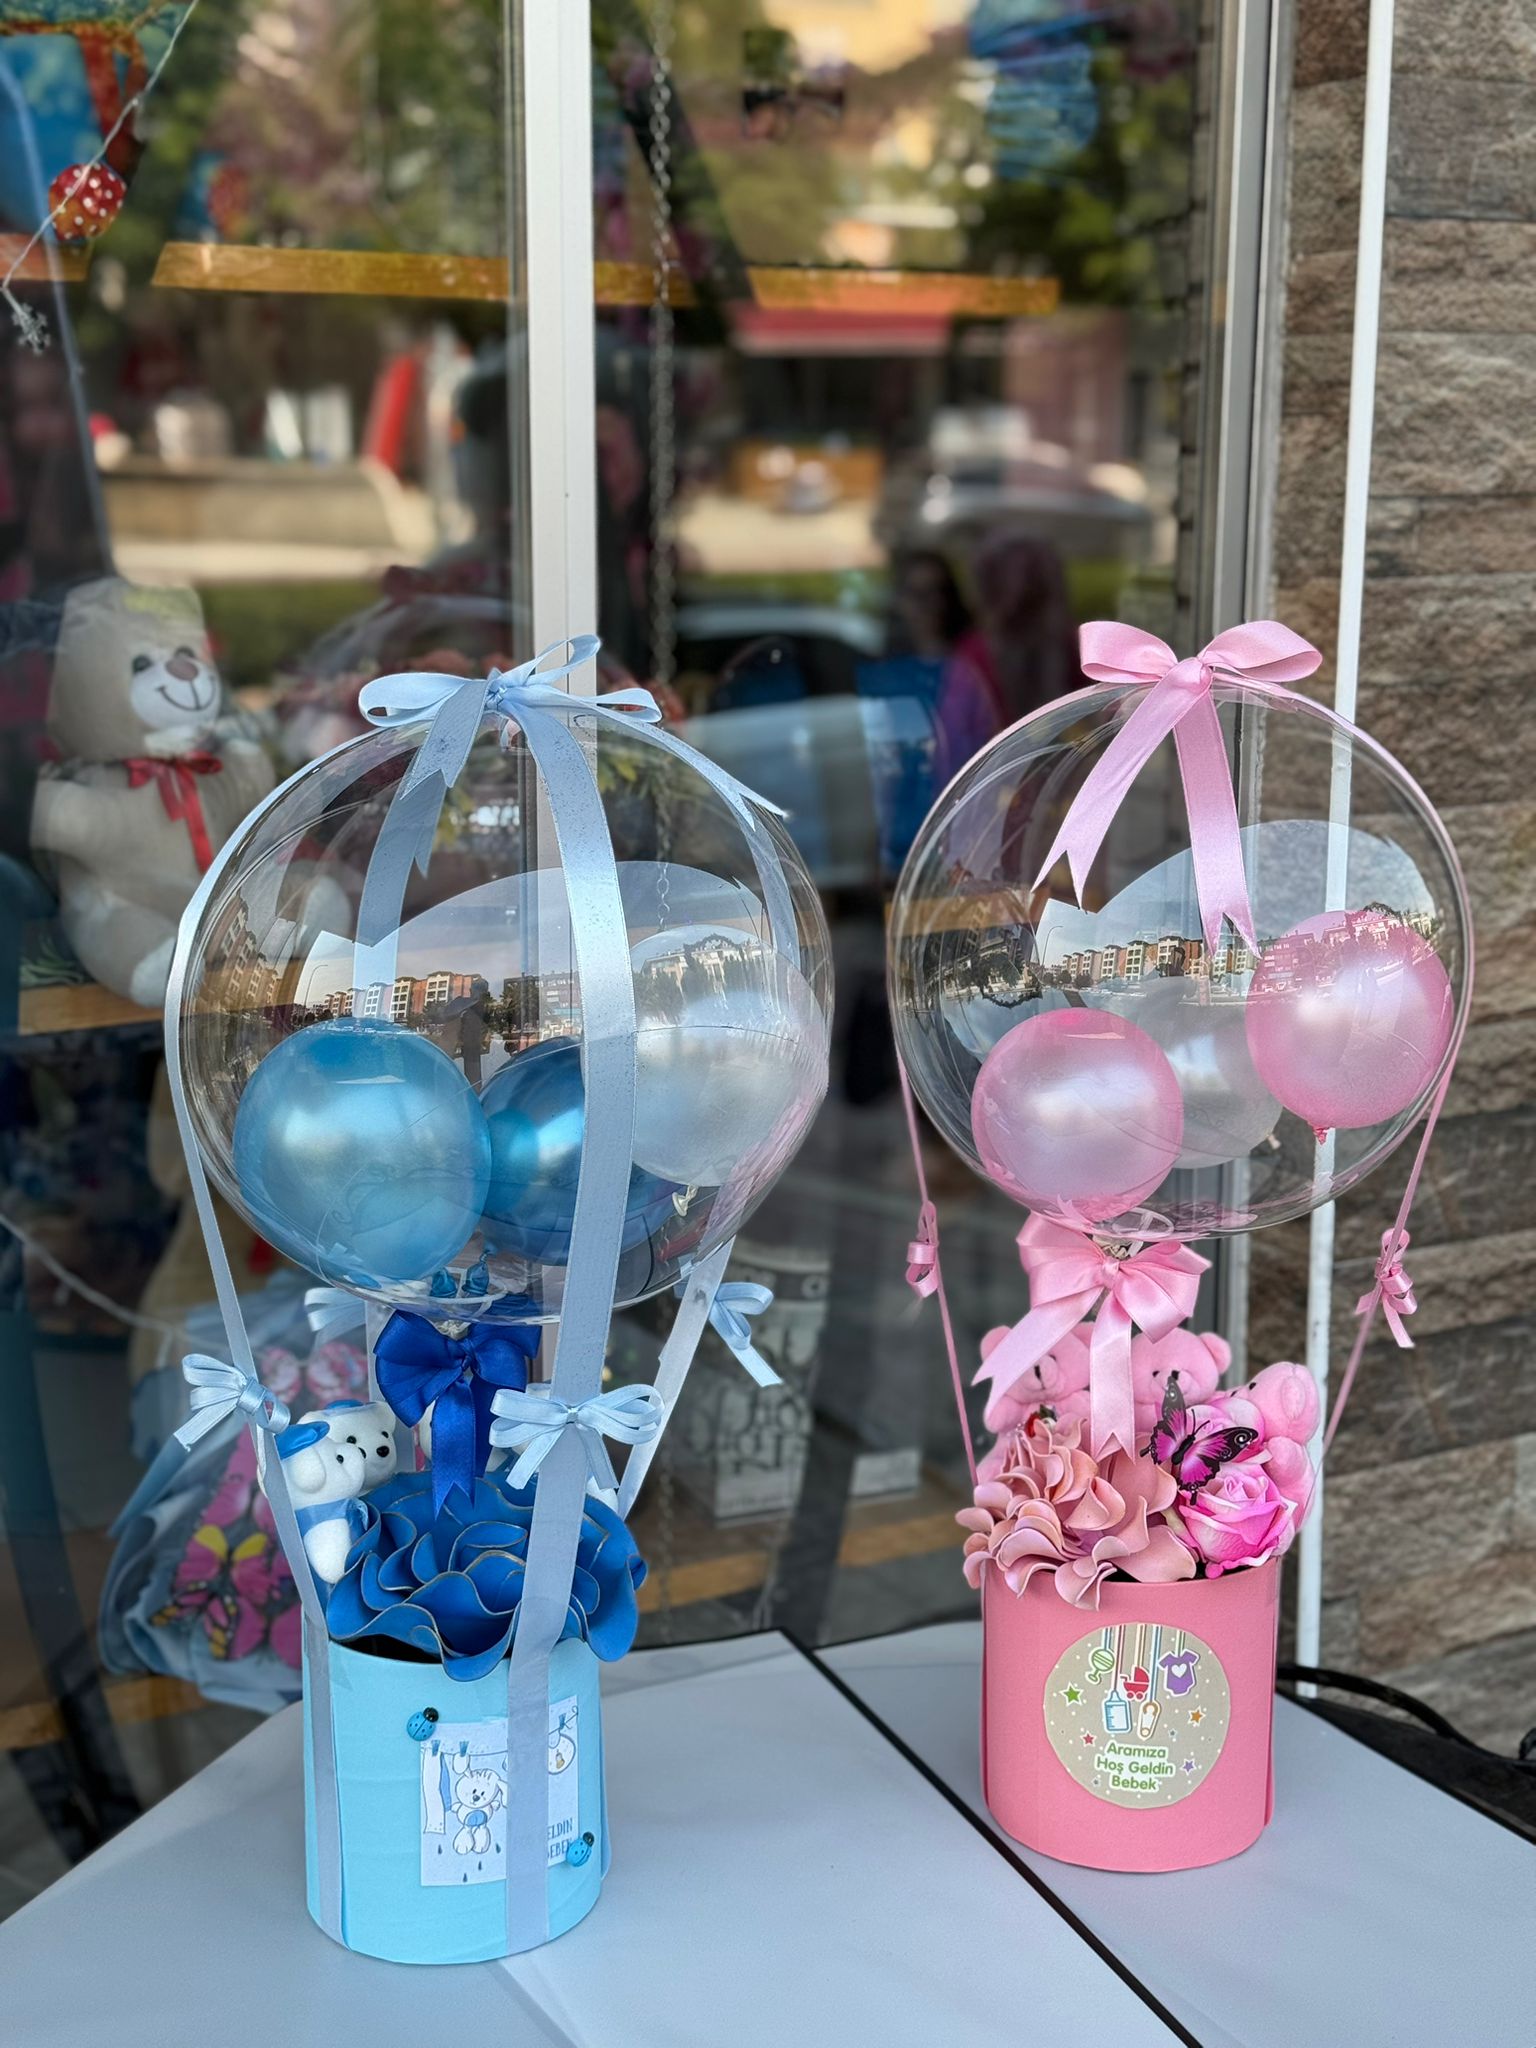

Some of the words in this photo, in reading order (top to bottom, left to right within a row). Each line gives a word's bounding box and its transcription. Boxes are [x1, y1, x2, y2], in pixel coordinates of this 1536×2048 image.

[1106, 1742, 1167, 1759] Aramıza
[1097, 1756, 1124, 1775] Hoş
[1128, 1761, 1174, 1775] Geldin
[1111, 1775, 1157, 1790] Bebek
[547, 1817, 573, 1840] ELDIN
